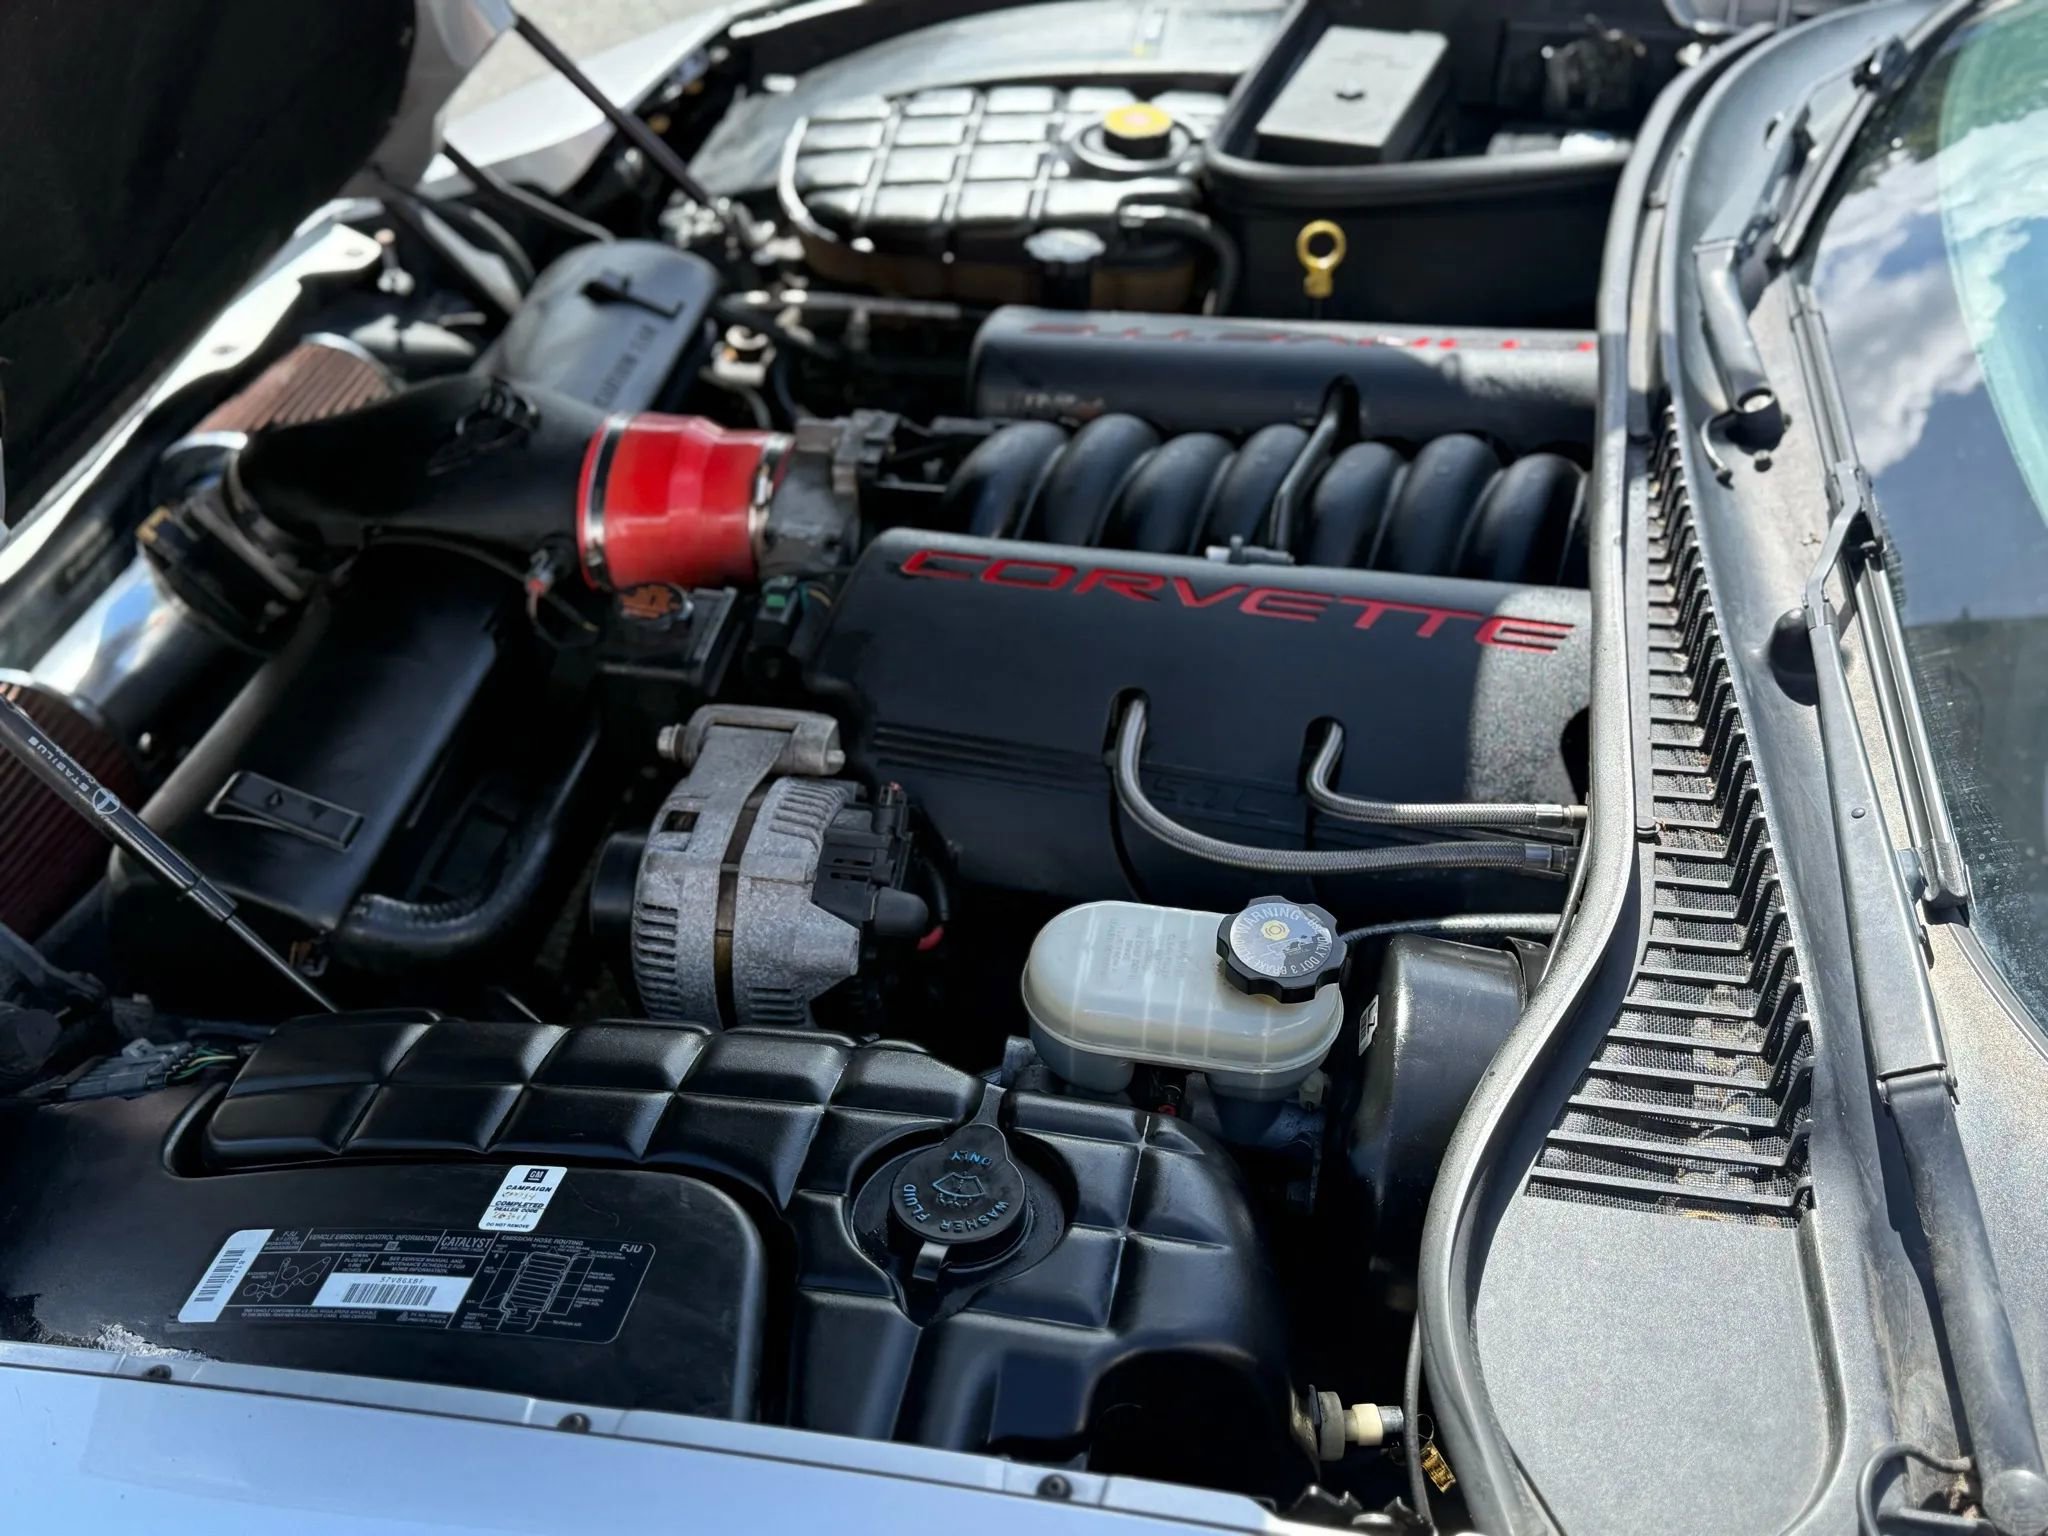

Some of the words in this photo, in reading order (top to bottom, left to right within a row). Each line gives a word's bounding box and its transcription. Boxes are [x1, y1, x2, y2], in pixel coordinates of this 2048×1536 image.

[900, 549, 1574, 653] CORVETTE
[28, 736, 89, 792] STABILUS
[1236, 907, 1300, 935] WARNING
[1315, 936, 1330, 959] ONLY
[1291, 965, 1299, 974] 3
[1300, 956, 1320, 973] DOT
[951, 1150, 993, 1167] ONLY
[529, 1170, 545, 1179] GM
[505, 1184, 552, 1193] CAMPAIGN
[494, 1200, 545, 1209] COMPLETED
[903, 1184, 931, 1222] FLUID
[940, 1201, 1009, 1232] WASHER
[309, 1233, 335, 1241] VEHICLE
[394, 1234, 440, 1242] INFORMATION
[441, 1235, 494, 1248] CATALYST
[620, 1243, 643, 1253] FJU
